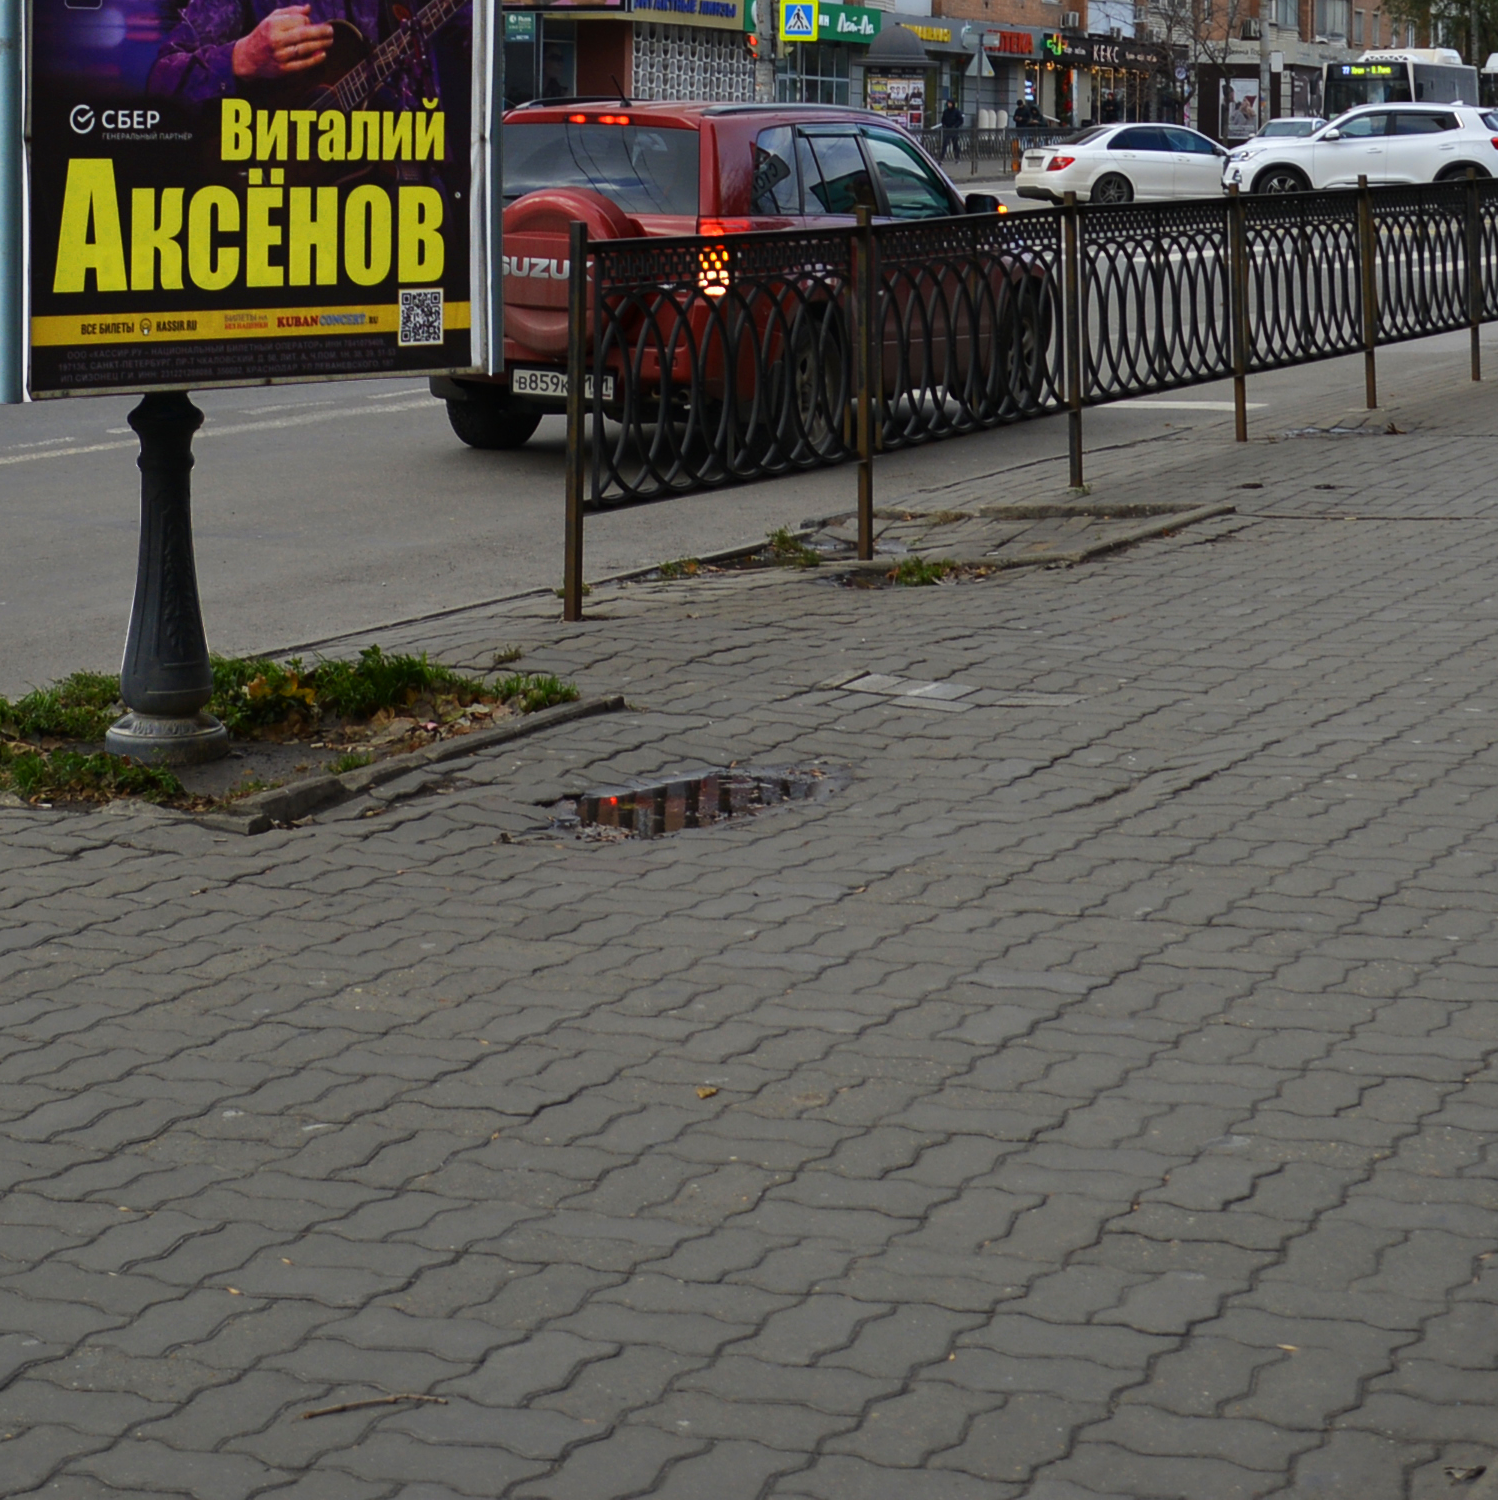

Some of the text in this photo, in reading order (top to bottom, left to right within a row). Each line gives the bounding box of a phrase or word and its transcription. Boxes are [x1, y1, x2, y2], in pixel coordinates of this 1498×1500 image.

[698, 0, 737, 18] ЛИНЗЫ
[101, 110, 160, 129] СБЕР
[102, 131, 158, 140] ГЕНЕРАЛЬНЫЙ
[221, 97, 445, 161] Виталий
[502, 255, 593, 282] SUZU
[81, 322, 135, 335] ВСЕ БИЛЕТЫ
[156, 320, 197, 332] KASSIR.RU
[517, 373, 611, 396] В859К 11
